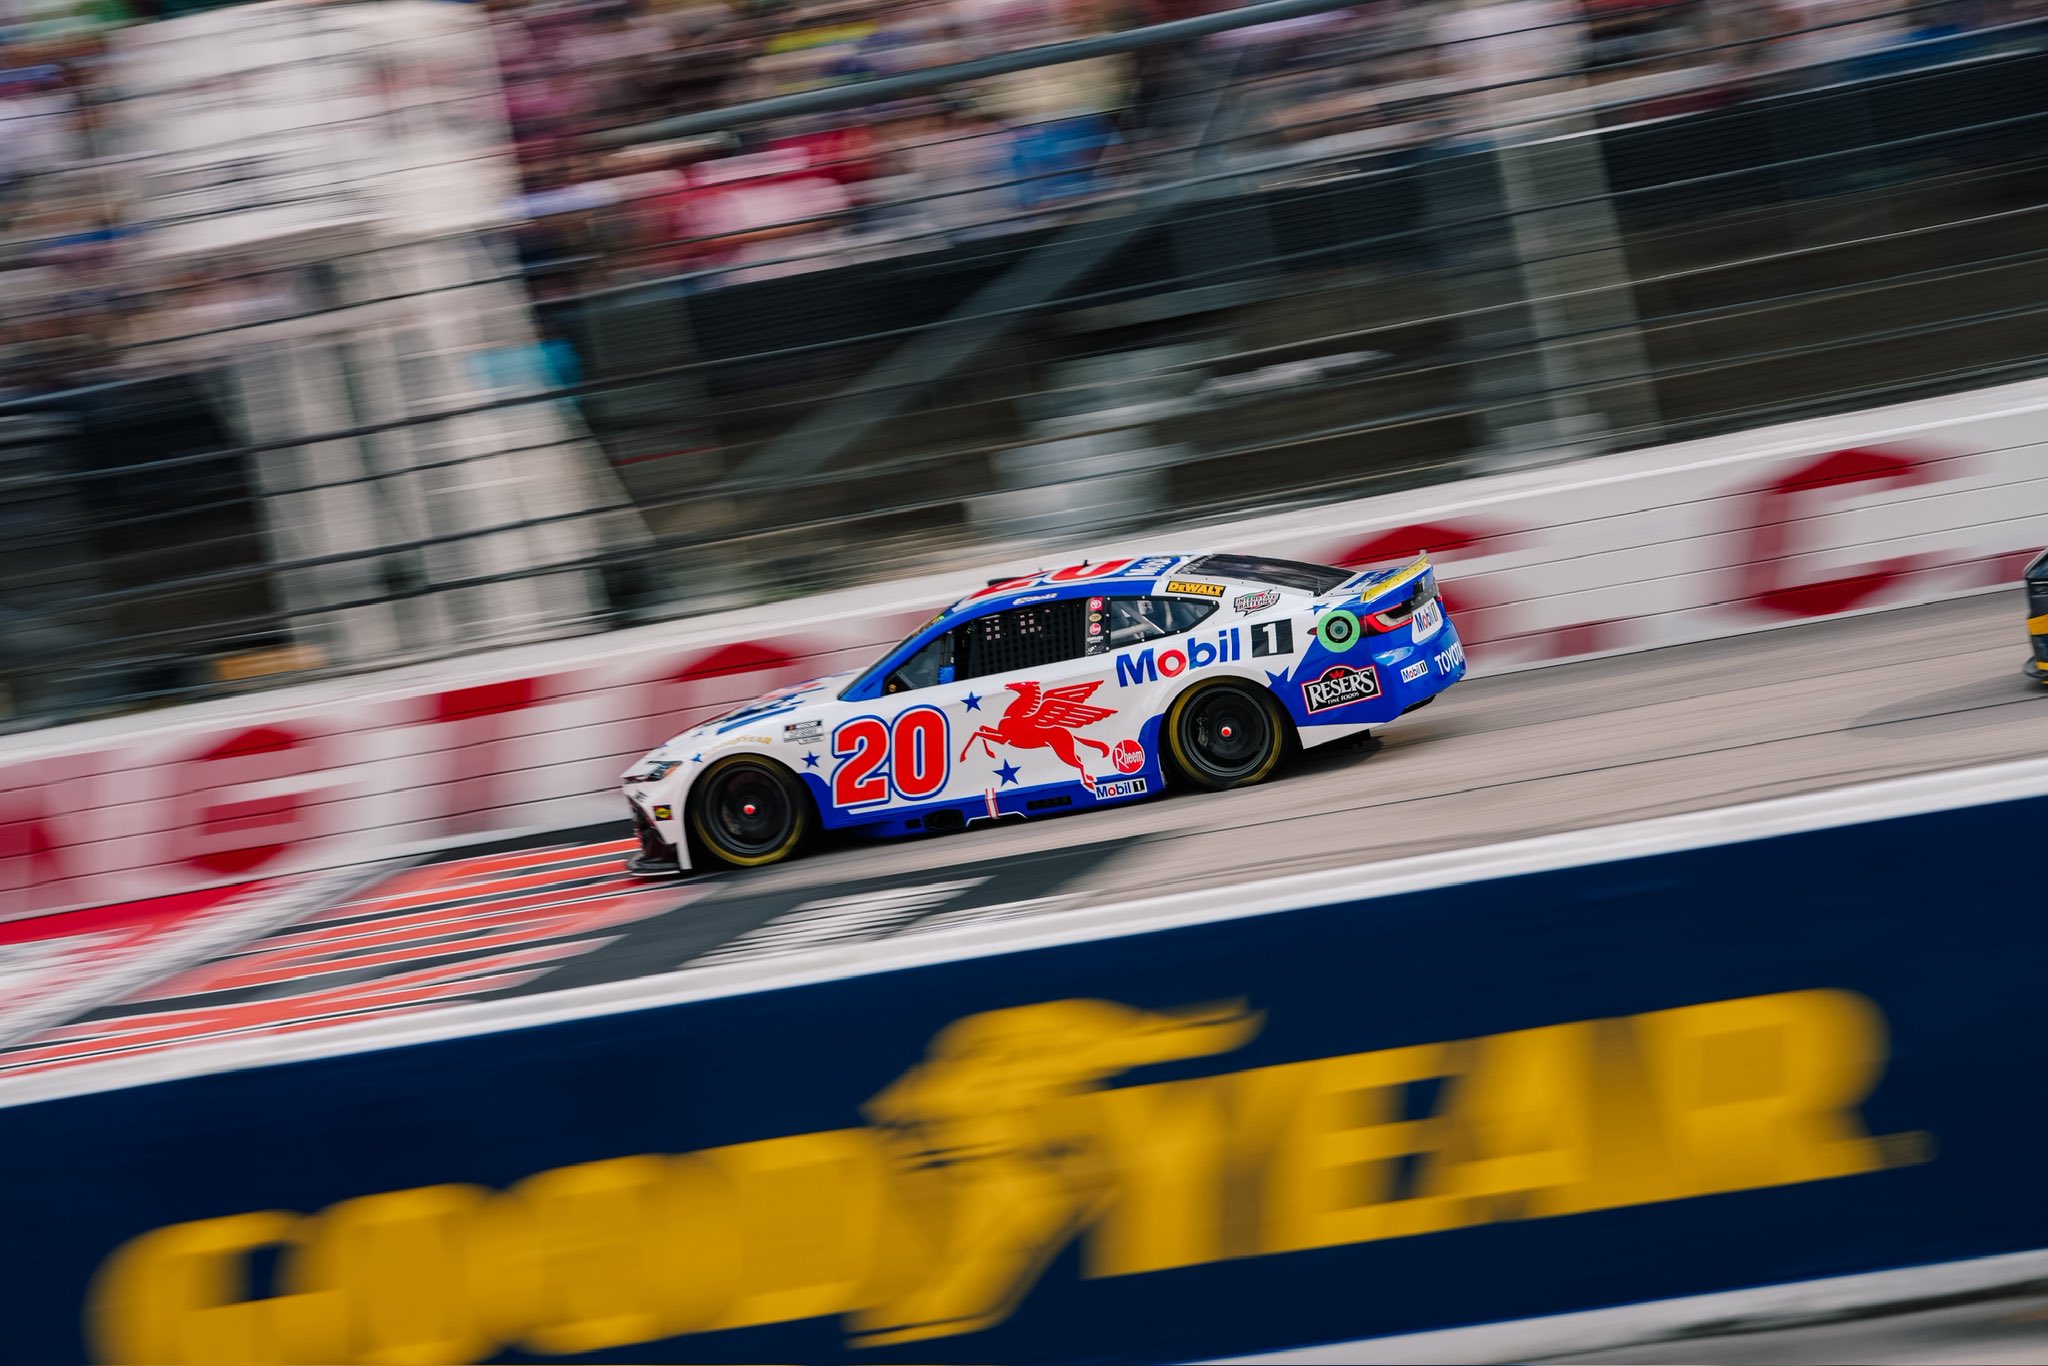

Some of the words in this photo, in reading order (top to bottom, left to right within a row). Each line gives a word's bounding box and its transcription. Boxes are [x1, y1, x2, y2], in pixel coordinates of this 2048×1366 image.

[1116, 627, 1240, 688] Mobil
[1402, 663, 1421, 681] Mobil
[1308, 671, 1375, 710] RESER'S
[1327, 697, 1340, 705] FINE
[1341, 692, 1360, 702] FOODS
[833, 706, 949, 808] 20
[1114, 740, 1144, 770] Rheem
[1096, 781, 1131, 798] Mobil
